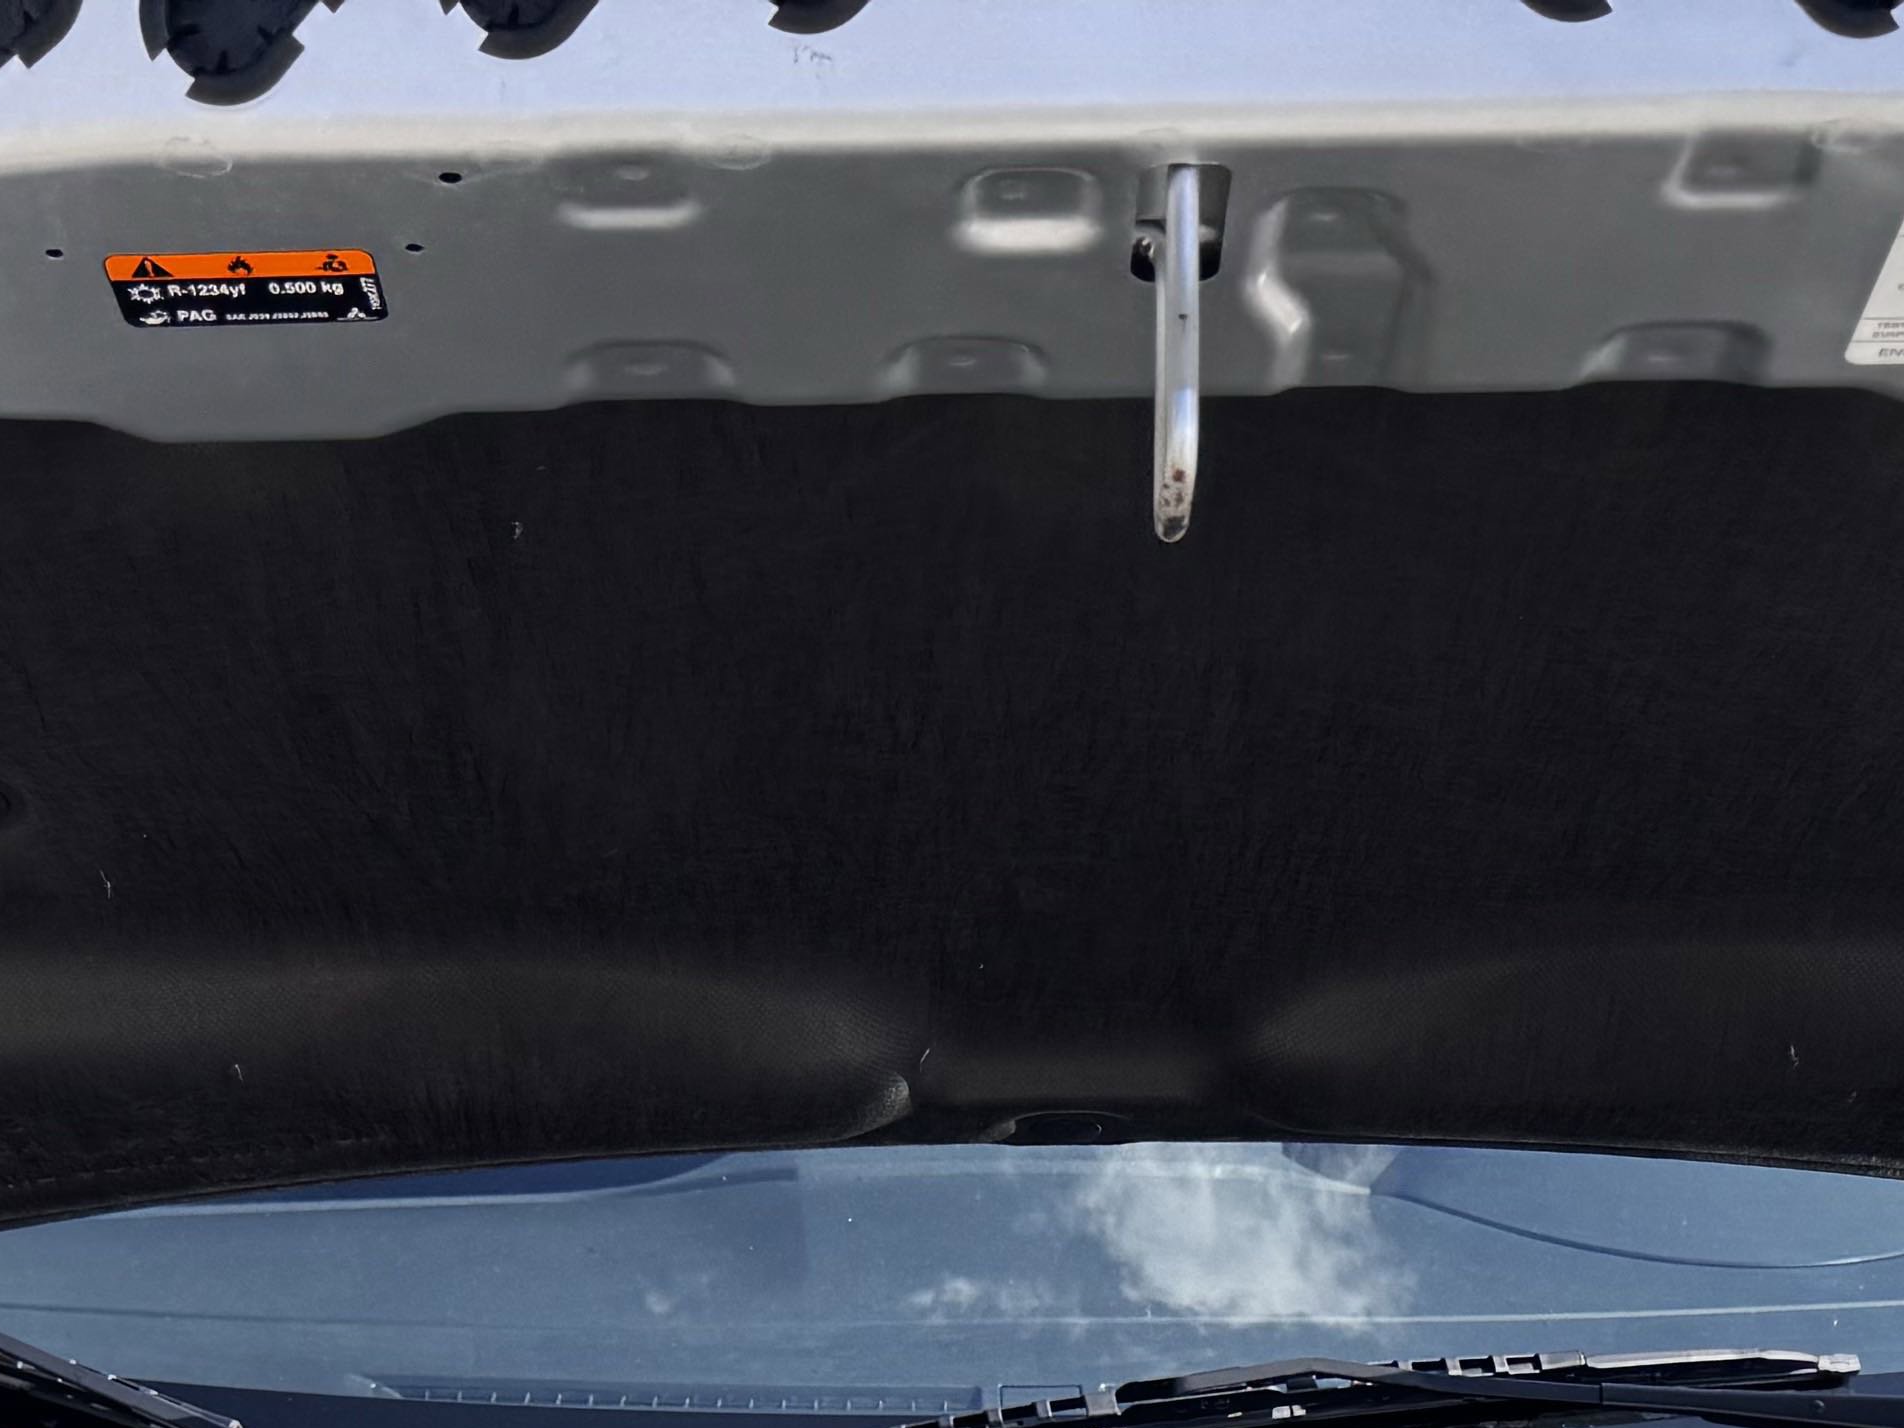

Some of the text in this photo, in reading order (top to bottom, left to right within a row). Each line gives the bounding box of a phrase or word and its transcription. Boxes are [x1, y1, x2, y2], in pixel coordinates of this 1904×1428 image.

[168, 283, 246, 298] R-1234yf
[268, 282, 317, 295] 0.500
[321, 281, 344, 296] kg
[177, 310, 217, 322] PAG
